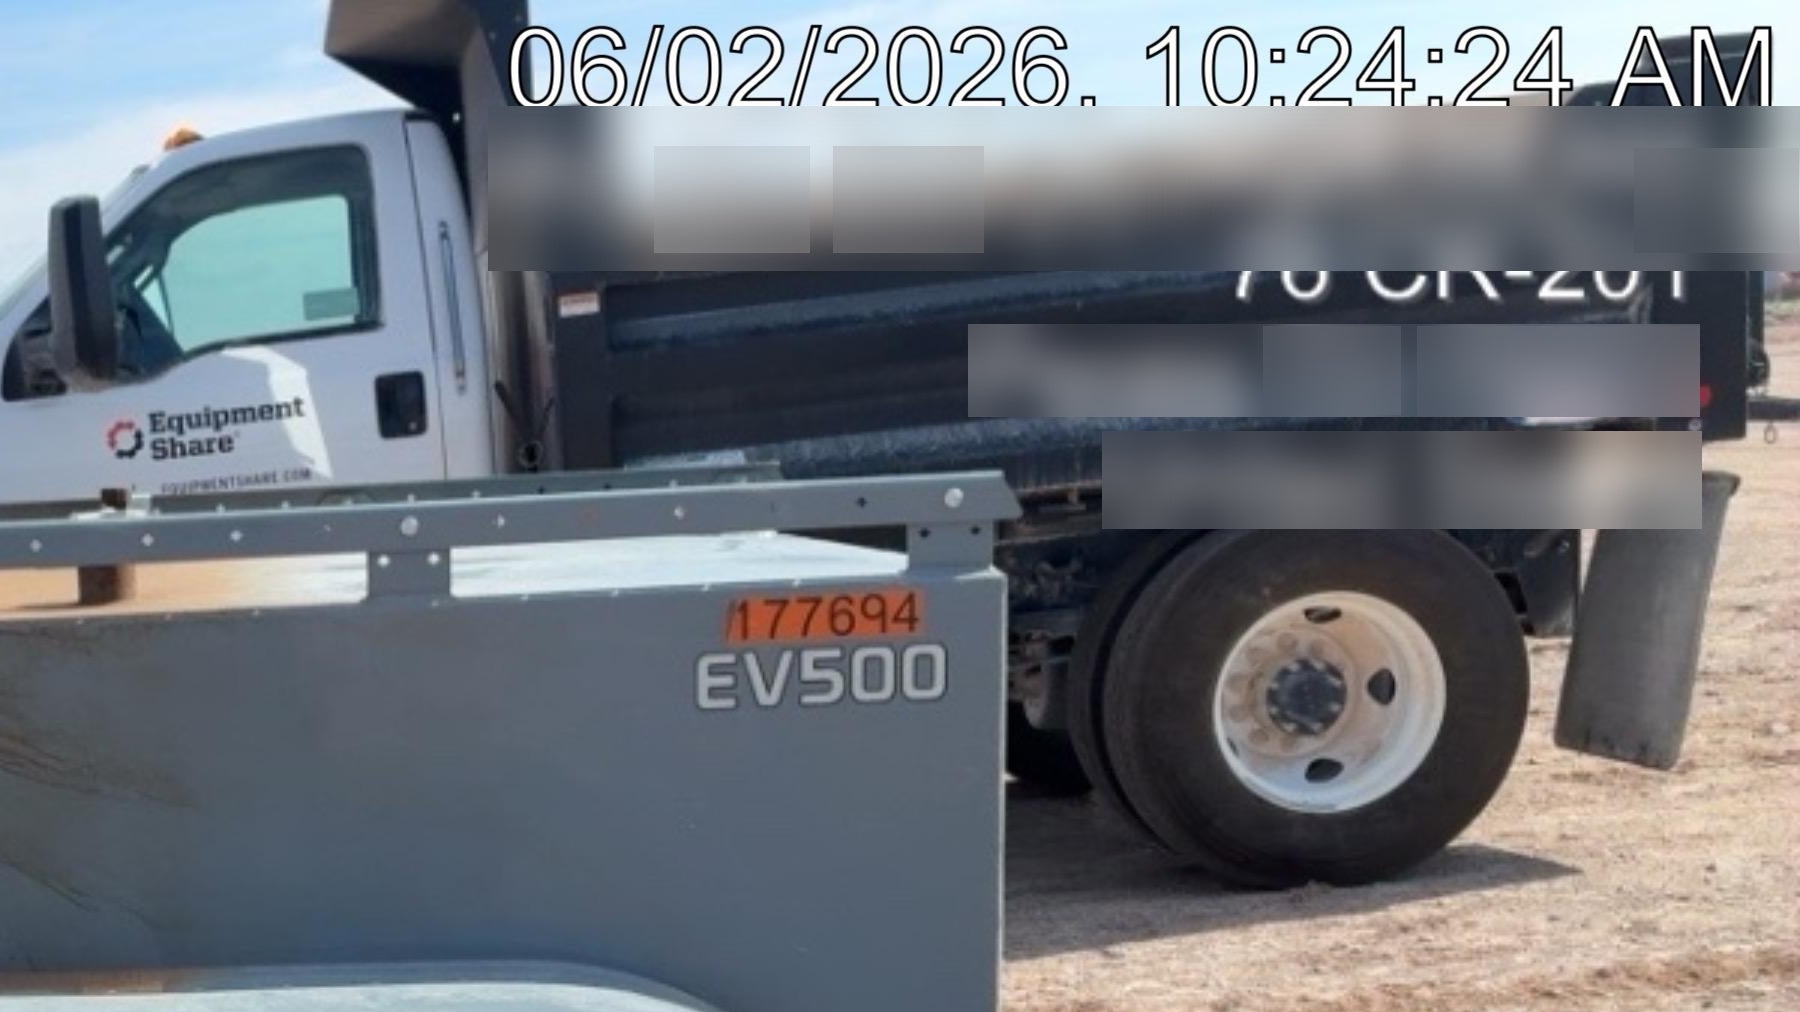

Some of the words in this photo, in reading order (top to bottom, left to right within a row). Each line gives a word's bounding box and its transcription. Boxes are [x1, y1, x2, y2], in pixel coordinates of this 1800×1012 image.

[149, 397, 305, 435] Equipment
[151, 434, 234, 460] Share
[733, 590, 920, 641] 177694
[697, 643, 948, 709] EV500
